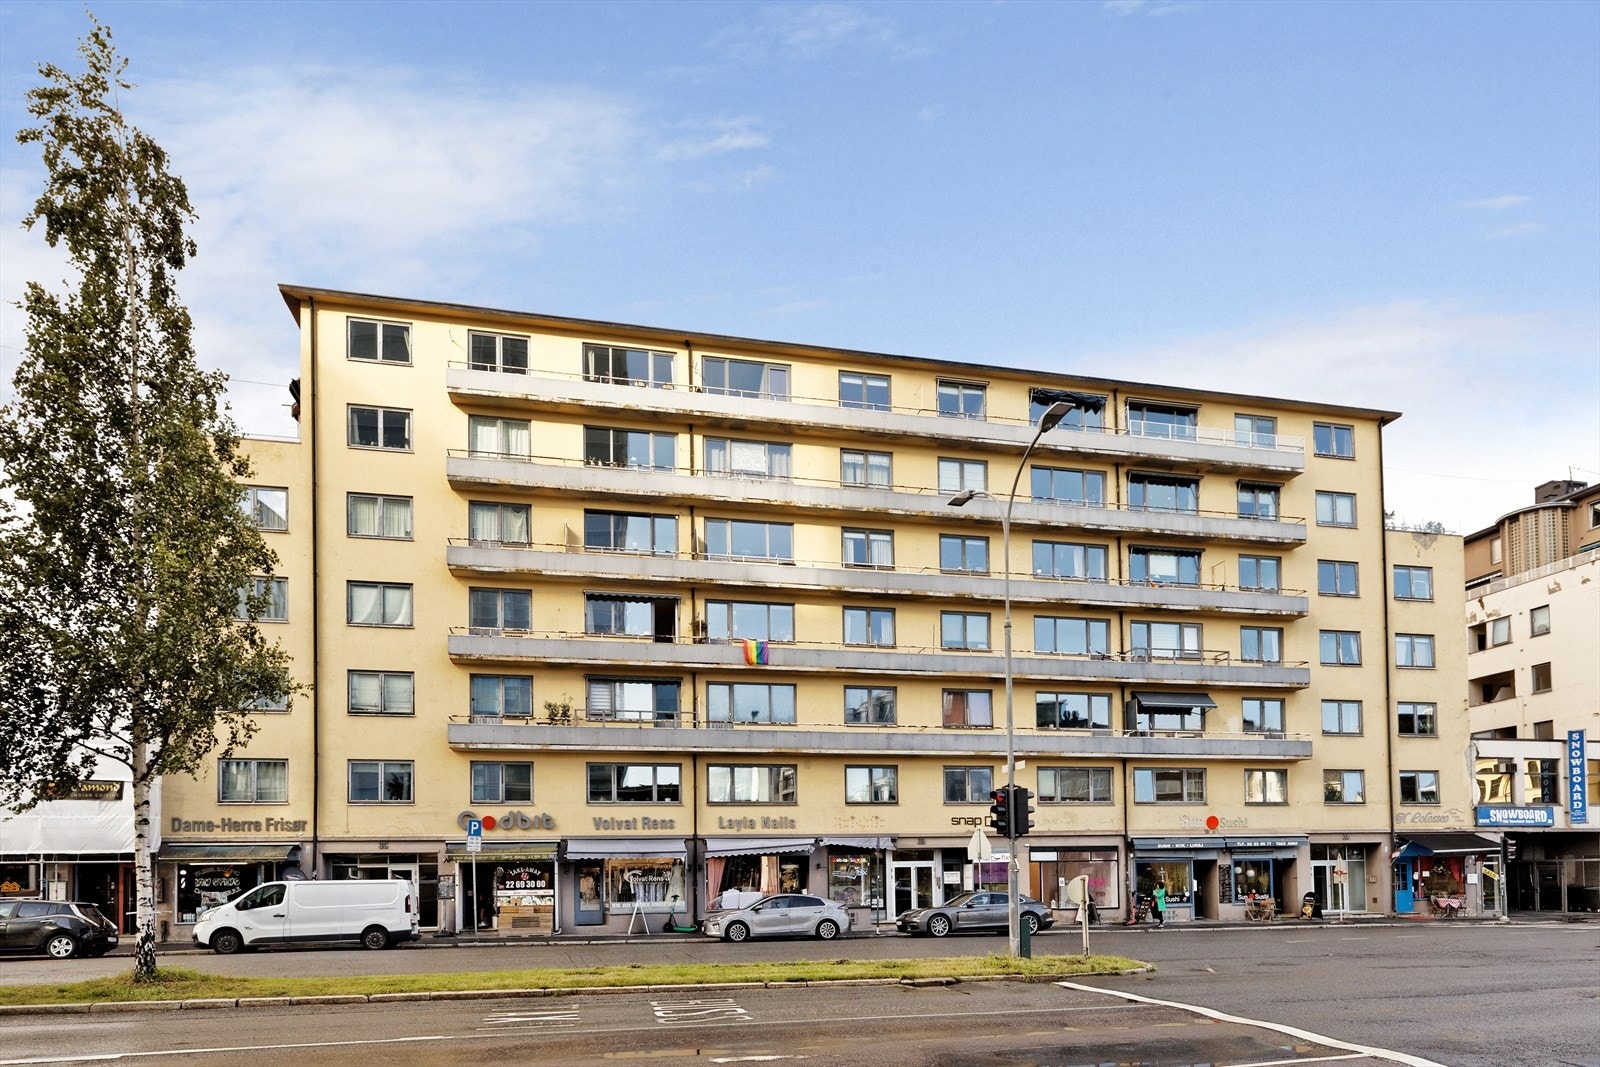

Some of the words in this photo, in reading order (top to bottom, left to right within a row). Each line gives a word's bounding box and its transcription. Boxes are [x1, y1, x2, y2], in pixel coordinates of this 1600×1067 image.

[1570, 732, 1584, 809] SNOWBOARD
[171, 817, 262, 832] Dame-Herre
[265, 817, 307, 832] Frisør
[471, 821, 479, 835] P
[593, 817, 638, 830] Volvat
[641, 816, 676, 830] Rens
[718, 816, 756, 832] Layla
[761, 816, 796, 829] Nails
[951, 817, 982, 828] snap
[1181, 815, 1205, 828] Sun
[1219, 817, 1248, 828] Sushi
[505, 881, 515, 889] 22
[536, 880, 546, 888] 00
